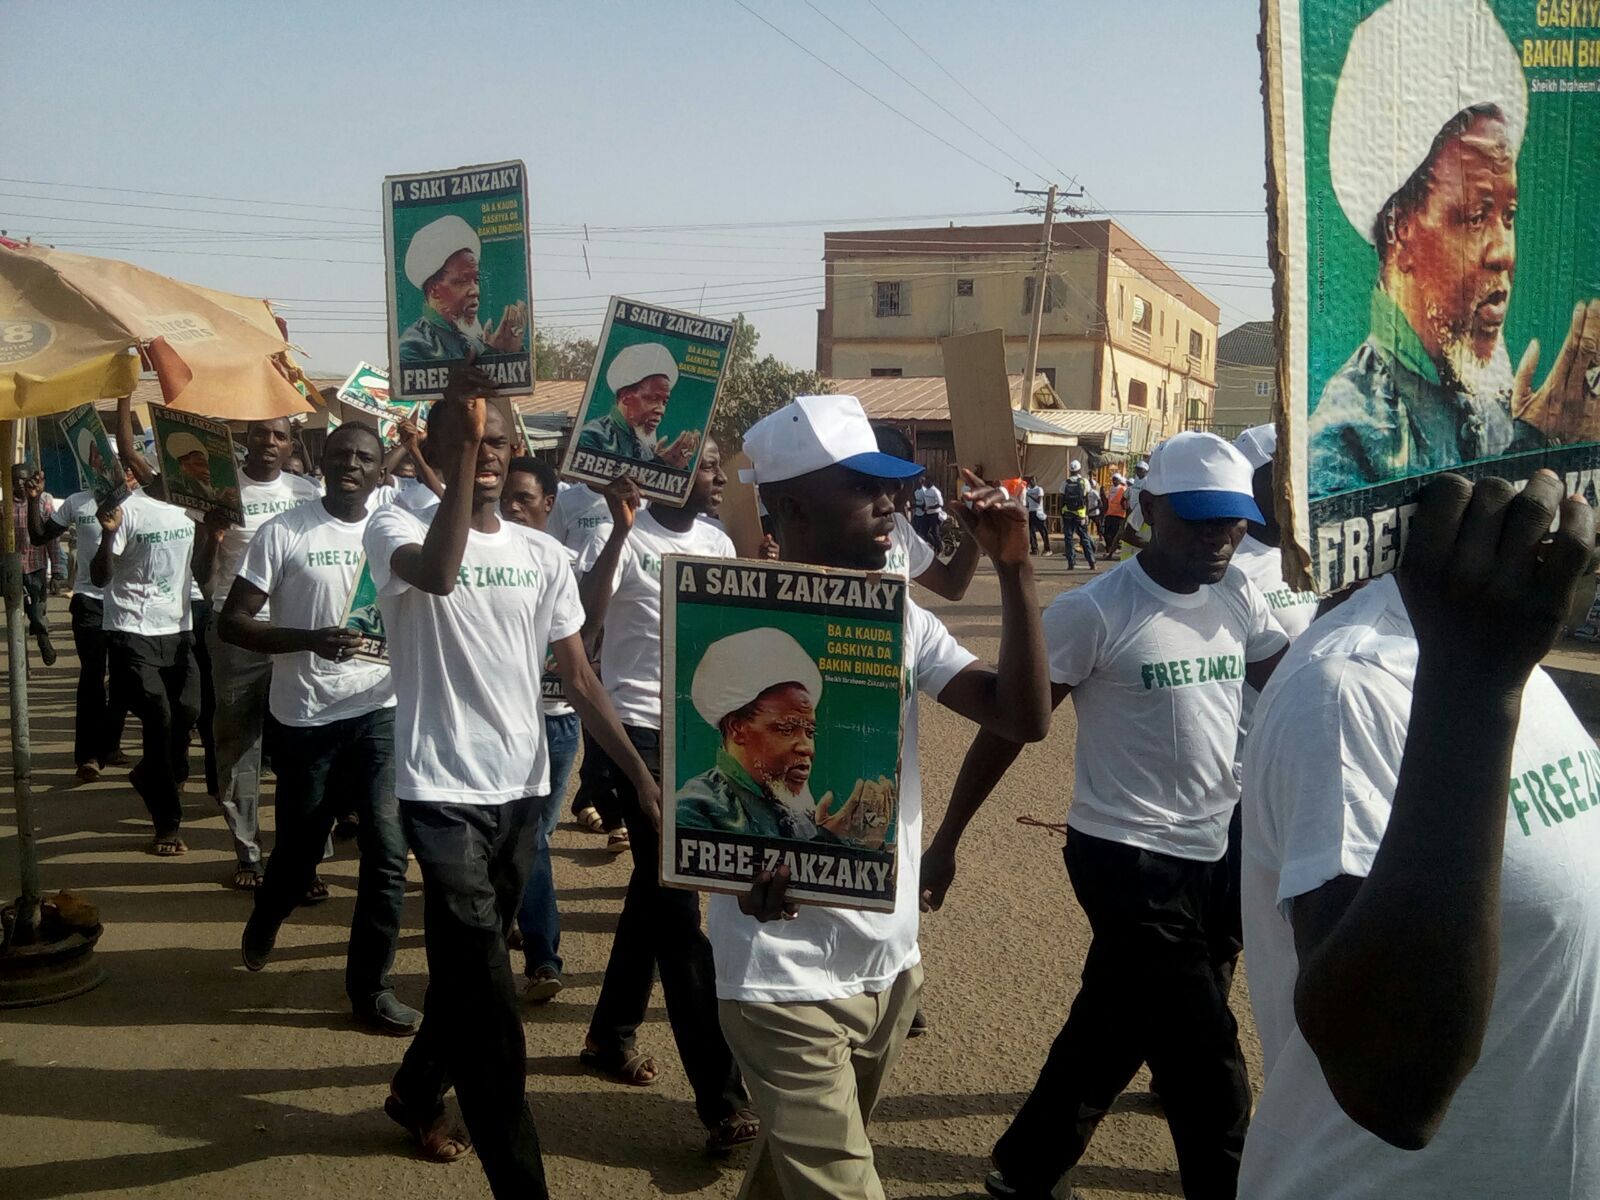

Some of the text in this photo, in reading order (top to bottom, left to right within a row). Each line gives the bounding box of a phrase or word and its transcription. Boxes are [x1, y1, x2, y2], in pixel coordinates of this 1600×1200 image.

[1536, 0, 1600, 27] GASKIY
[1523, 40, 1574, 67] BAKIN
[1532, 79, 1557, 92] Sheikh
[394, 168, 518, 201] A SAKI ZAKZAKY
[616, 304, 730, 341] A SAKI ZAKZAKY
[404, 367, 449, 390] FREE
[476, 361, 528, 385] ZAKY
[573, 452, 616, 476] FREE
[243, 503, 260, 515] REE
[136, 532, 162, 543] FREE
[308, 550, 341, 567] FREE
[474, 566, 539, 588] ZAKZAKY
[679, 565, 899, 610] A SAKI ZAKZAKY
[828, 624, 892, 642] BA A KAUDA
[827, 641, 891, 660] GASKIYA DA
[819, 657, 899, 678] BAKIN BINDIGA
[1141, 659, 1193, 689] FREE
[1509, 756, 1589, 836] FREE
[680, 838, 889, 892] FREE ZAKZAKY
